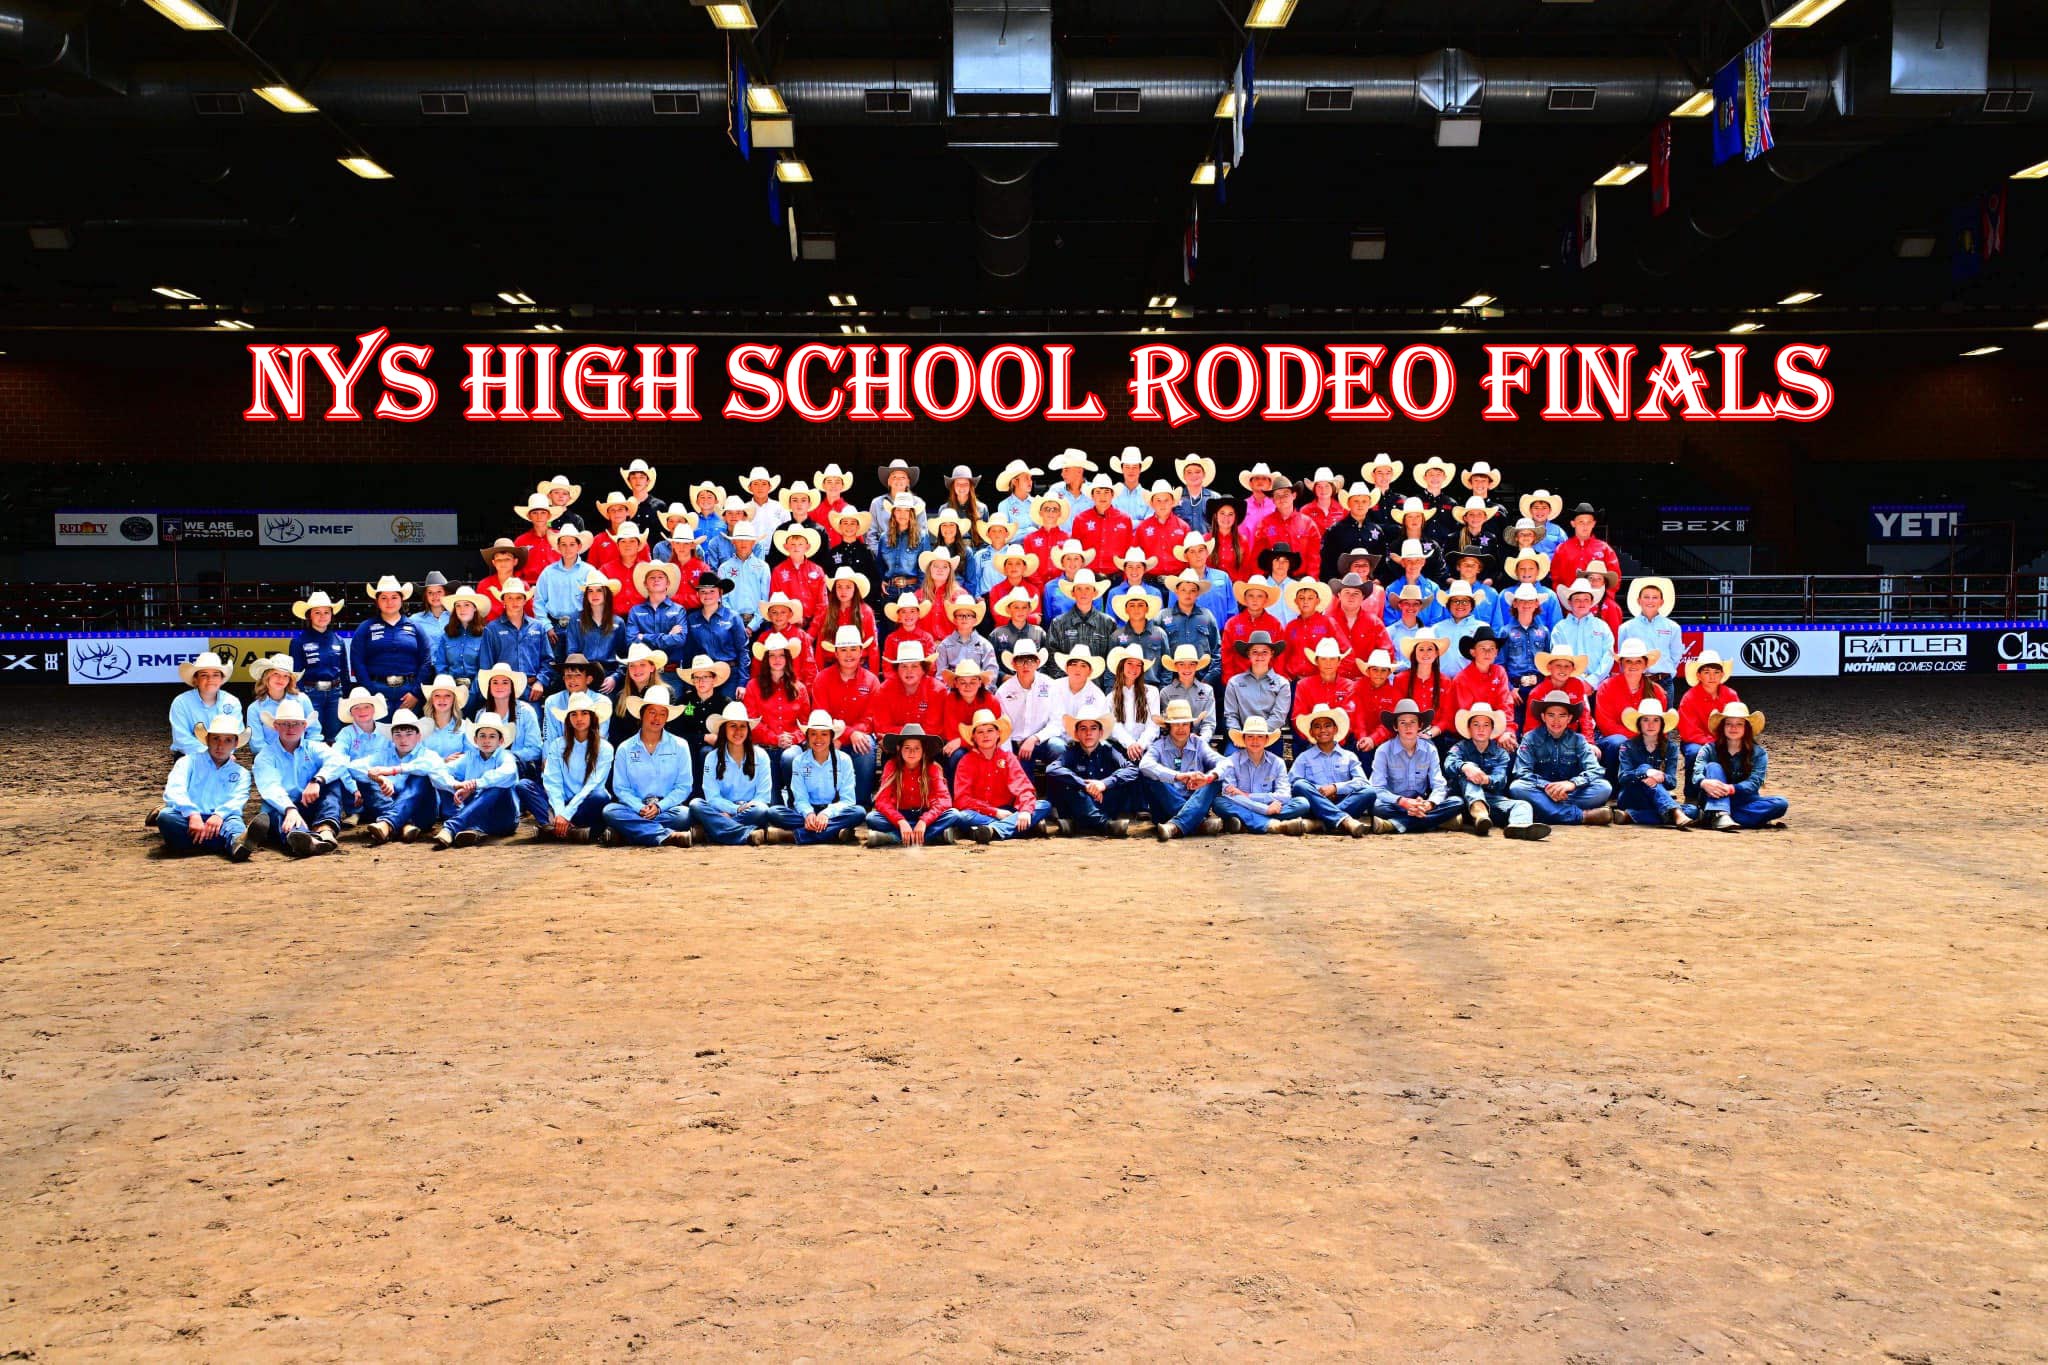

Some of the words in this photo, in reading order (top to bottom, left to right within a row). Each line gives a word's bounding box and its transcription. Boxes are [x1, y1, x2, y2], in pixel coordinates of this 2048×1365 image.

[184, 521, 205, 530] WE
[208, 521, 234, 530] ARE
[308, 525, 354, 535] RMEF
[1662, 520, 1732, 532] BEX
[1874, 512, 1958, 537] YETI
[1850, 637, 1962, 653] RATTLER
[1750, 638, 1790, 668] NRS
[1844, 662, 1896, 673] NOTHING
[1897, 661, 1933, 672] COMES
[1934, 660, 1968, 671] CLOSE
